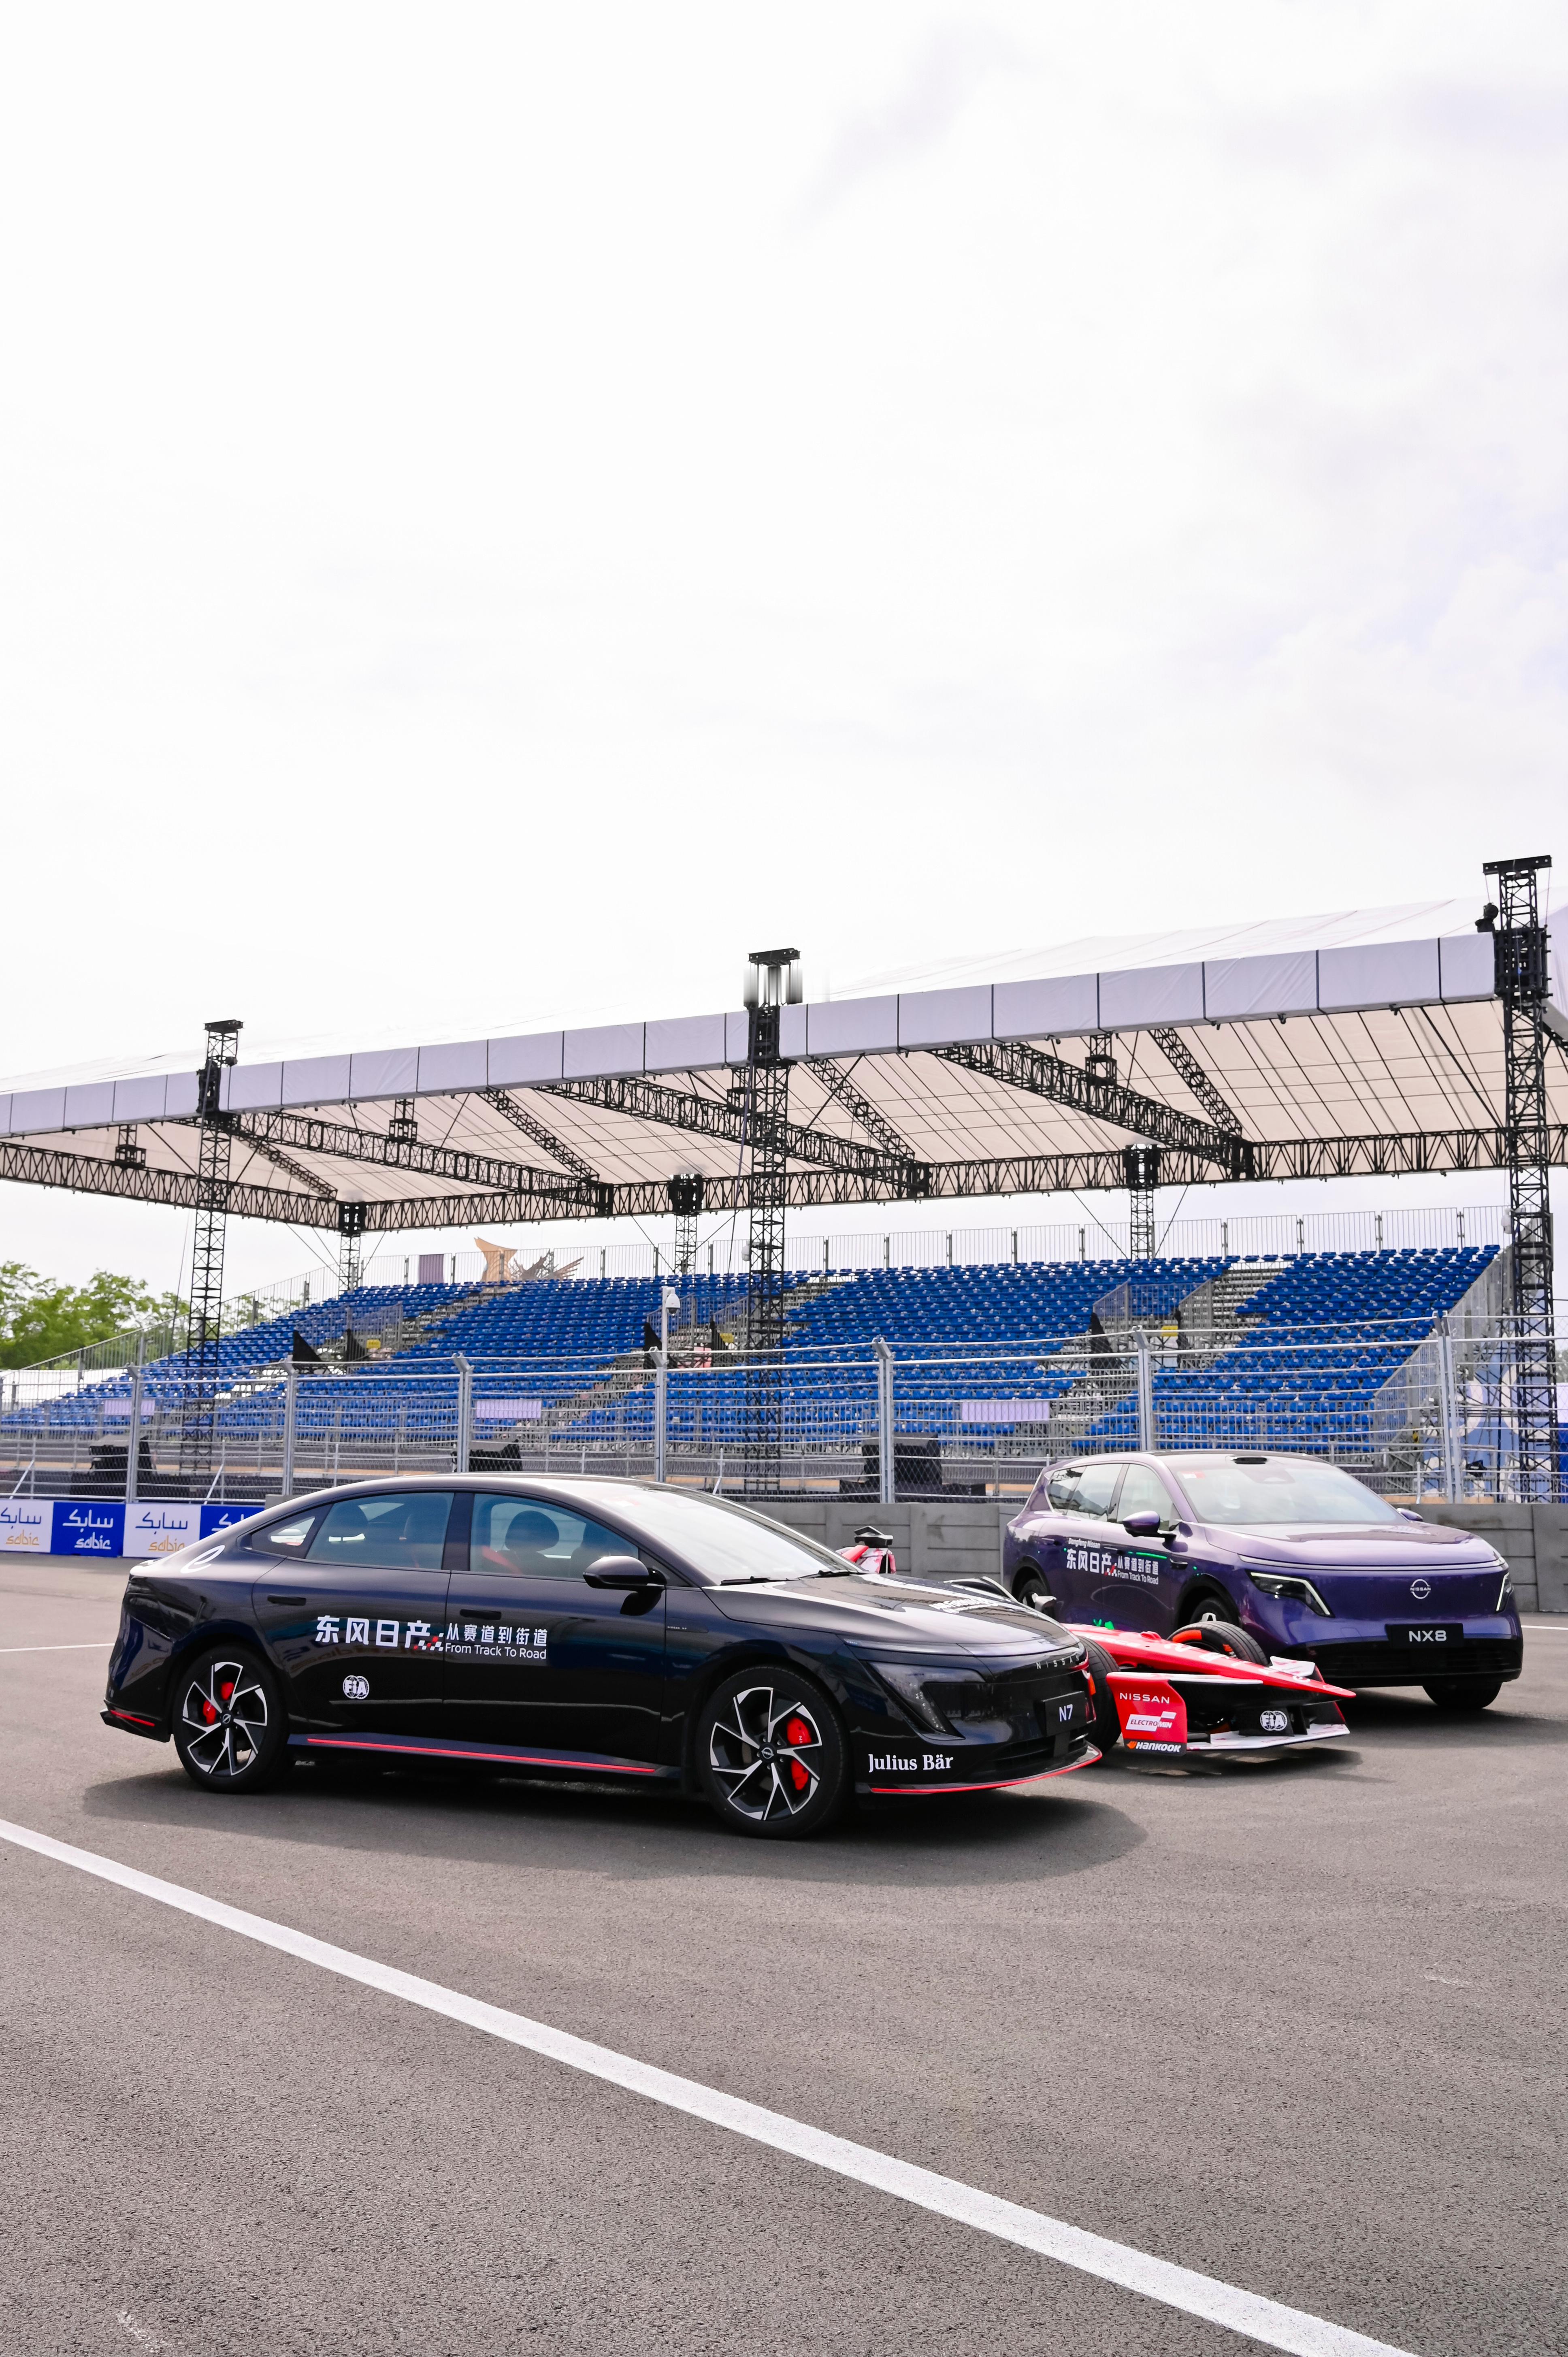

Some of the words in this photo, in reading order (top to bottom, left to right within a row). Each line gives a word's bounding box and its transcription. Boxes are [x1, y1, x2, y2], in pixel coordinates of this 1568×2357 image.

[62, 1509, 113, 1532] سابك
[135, 1508, 187, 1534] سابك
[6, 1530, 39, 1545] sabic
[74, 1532, 111, 1549] sabic
[1066, 1548, 1112, 1574] 东风日产
[1117, 1556, 1158, 1575] 从赛道到街道
[1117, 1570, 1129, 1579] From
[1129, 1572, 1141, 1581] Track
[1141, 1574, 1147, 1583] To
[1147, 1575, 1159, 1585] Road
[315, 1615, 430, 1648] 东风日产
[446, 1623, 548, 1647] 从赛道到街道
[1409, 1630, 1447, 1642] NX8
[445, 1643, 471, 1654] From
[474, 1645, 502, 1656] Track
[504, 1647, 517, 1657] To
[519, 1648, 547, 1659] Road
[1120, 1692, 1170, 1704] NISSAN
[1059, 1704, 1073, 1722] N7
[868, 1754, 918, 1773] Julius
[922, 1754, 954, 1770] Bär
